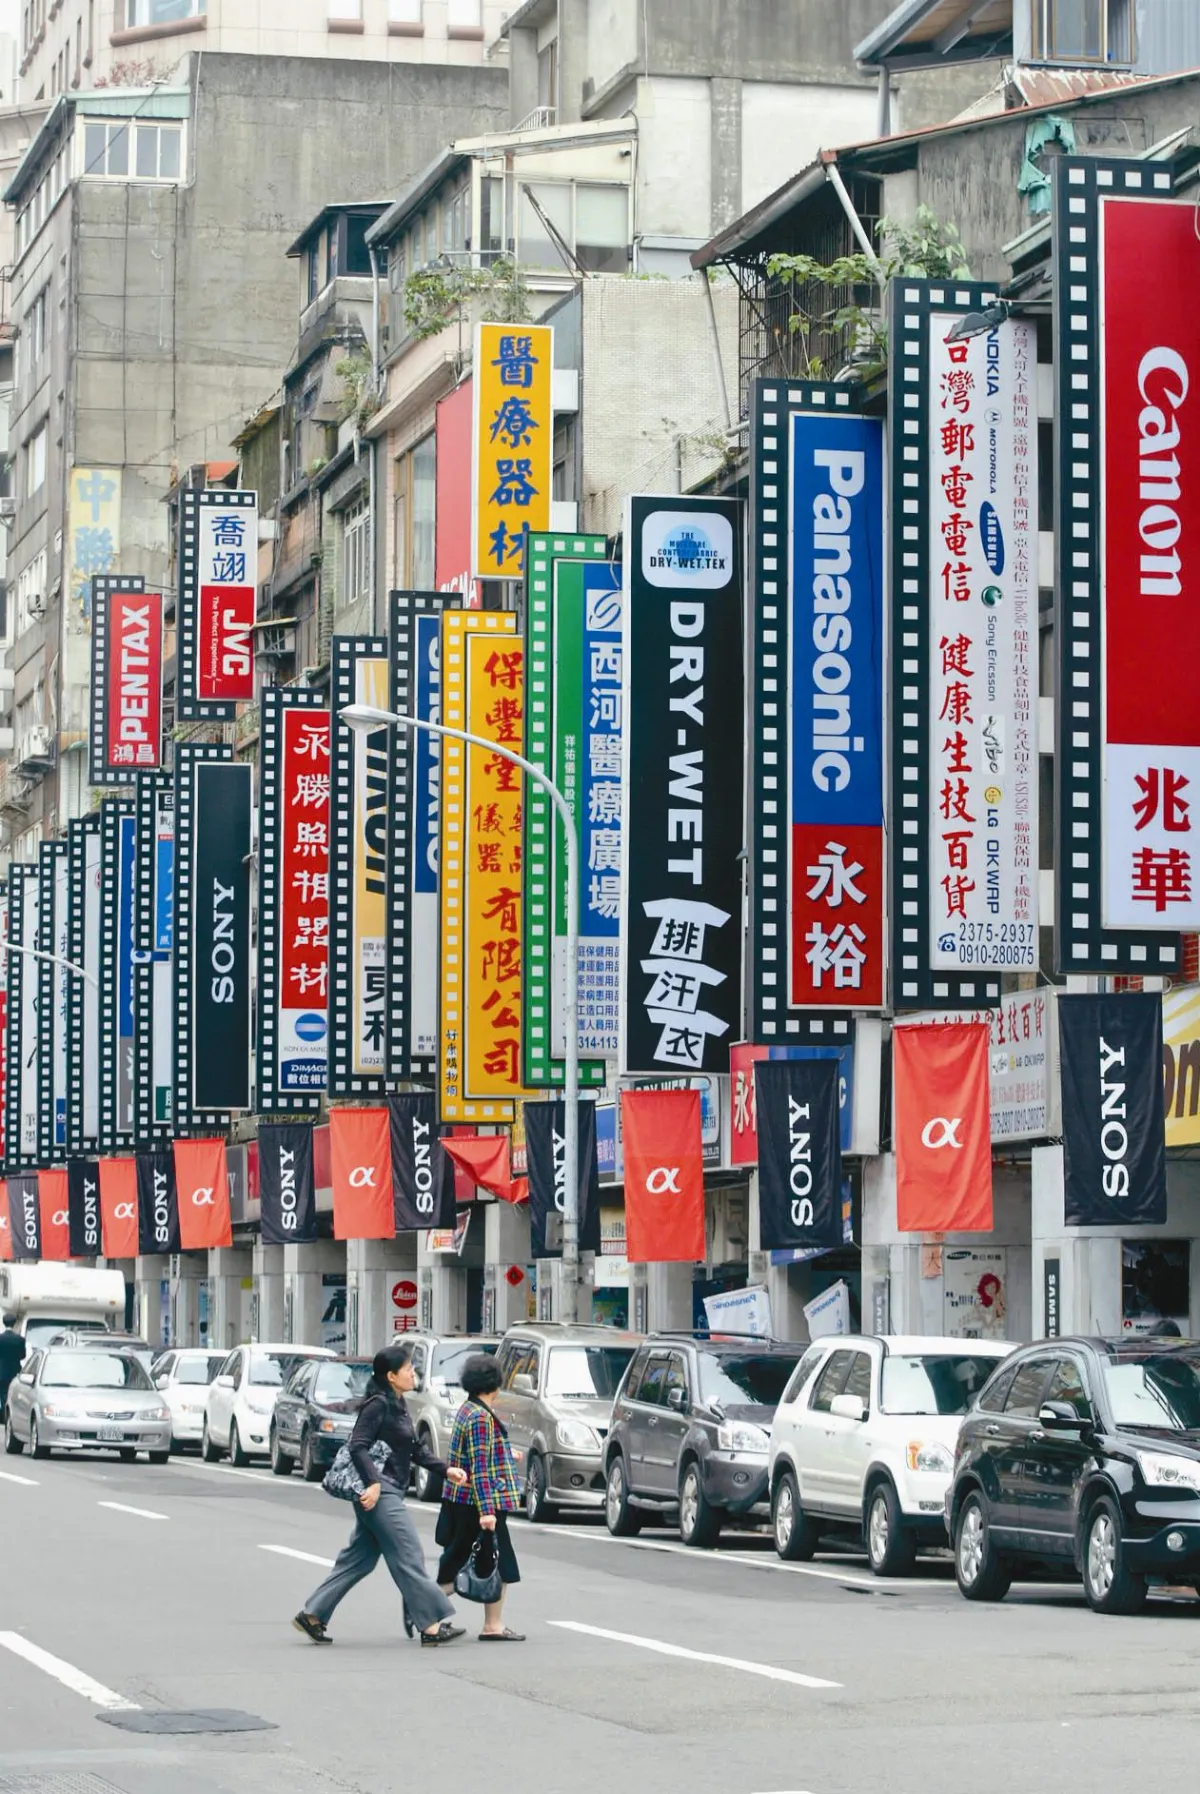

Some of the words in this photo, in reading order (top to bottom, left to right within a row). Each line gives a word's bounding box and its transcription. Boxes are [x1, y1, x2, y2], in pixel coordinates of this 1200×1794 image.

[987, 327, 999, 397] NOKIA
[488, 335, 541, 570] 醫療器材
[939, 336, 976, 602] 台灣郵電電信
[989, 428, 997, 494] MOTOROLA
[1137, 346, 1189, 597] Canon
[211, 513, 246, 583] 喬翊
[986, 511, 998, 567] SAMSUNG
[211, 596, 219, 610] The
[211, 611, 219, 636] Perfect
[812, 449, 866, 793] Panasonic
[986, 616, 997, 647] Sony
[121, 604, 151, 741] PENTAX
[211, 638, 219, 678] Experience
[222, 609, 250, 676] JVC
[987, 649, 998, 702] Ericsson
[588, 641, 622, 919] 西河醫療廣場
[667, 601, 705, 885] DRY-WET
[939, 633, 977, 919] 健康生技百貨
[987, 809, 999, 828] LG
[1132, 767, 1192, 912] 兆華
[987, 839, 1000, 914] OKWAP
[212, 877, 235, 1004] SONY
[804, 840, 868, 989] 永裕
[959, 922, 1034, 943] 2375-2937
[480, 886, 522, 1084] 有限公司
[959, 945, 1035, 966] 0910-280875
[1099, 1037, 1129, 1198] SONY
[279, 1145, 297, 1231] SONY
[412, 1116, 434, 1214] SONY
[788, 1094, 814, 1227] SONY
[23, 1190, 38, 1250] SONY
[84, 1178, 98, 1245] SONY
[153, 1168, 169, 1243] SONY
[1048, 1274, 1057, 1338] SAMSU
